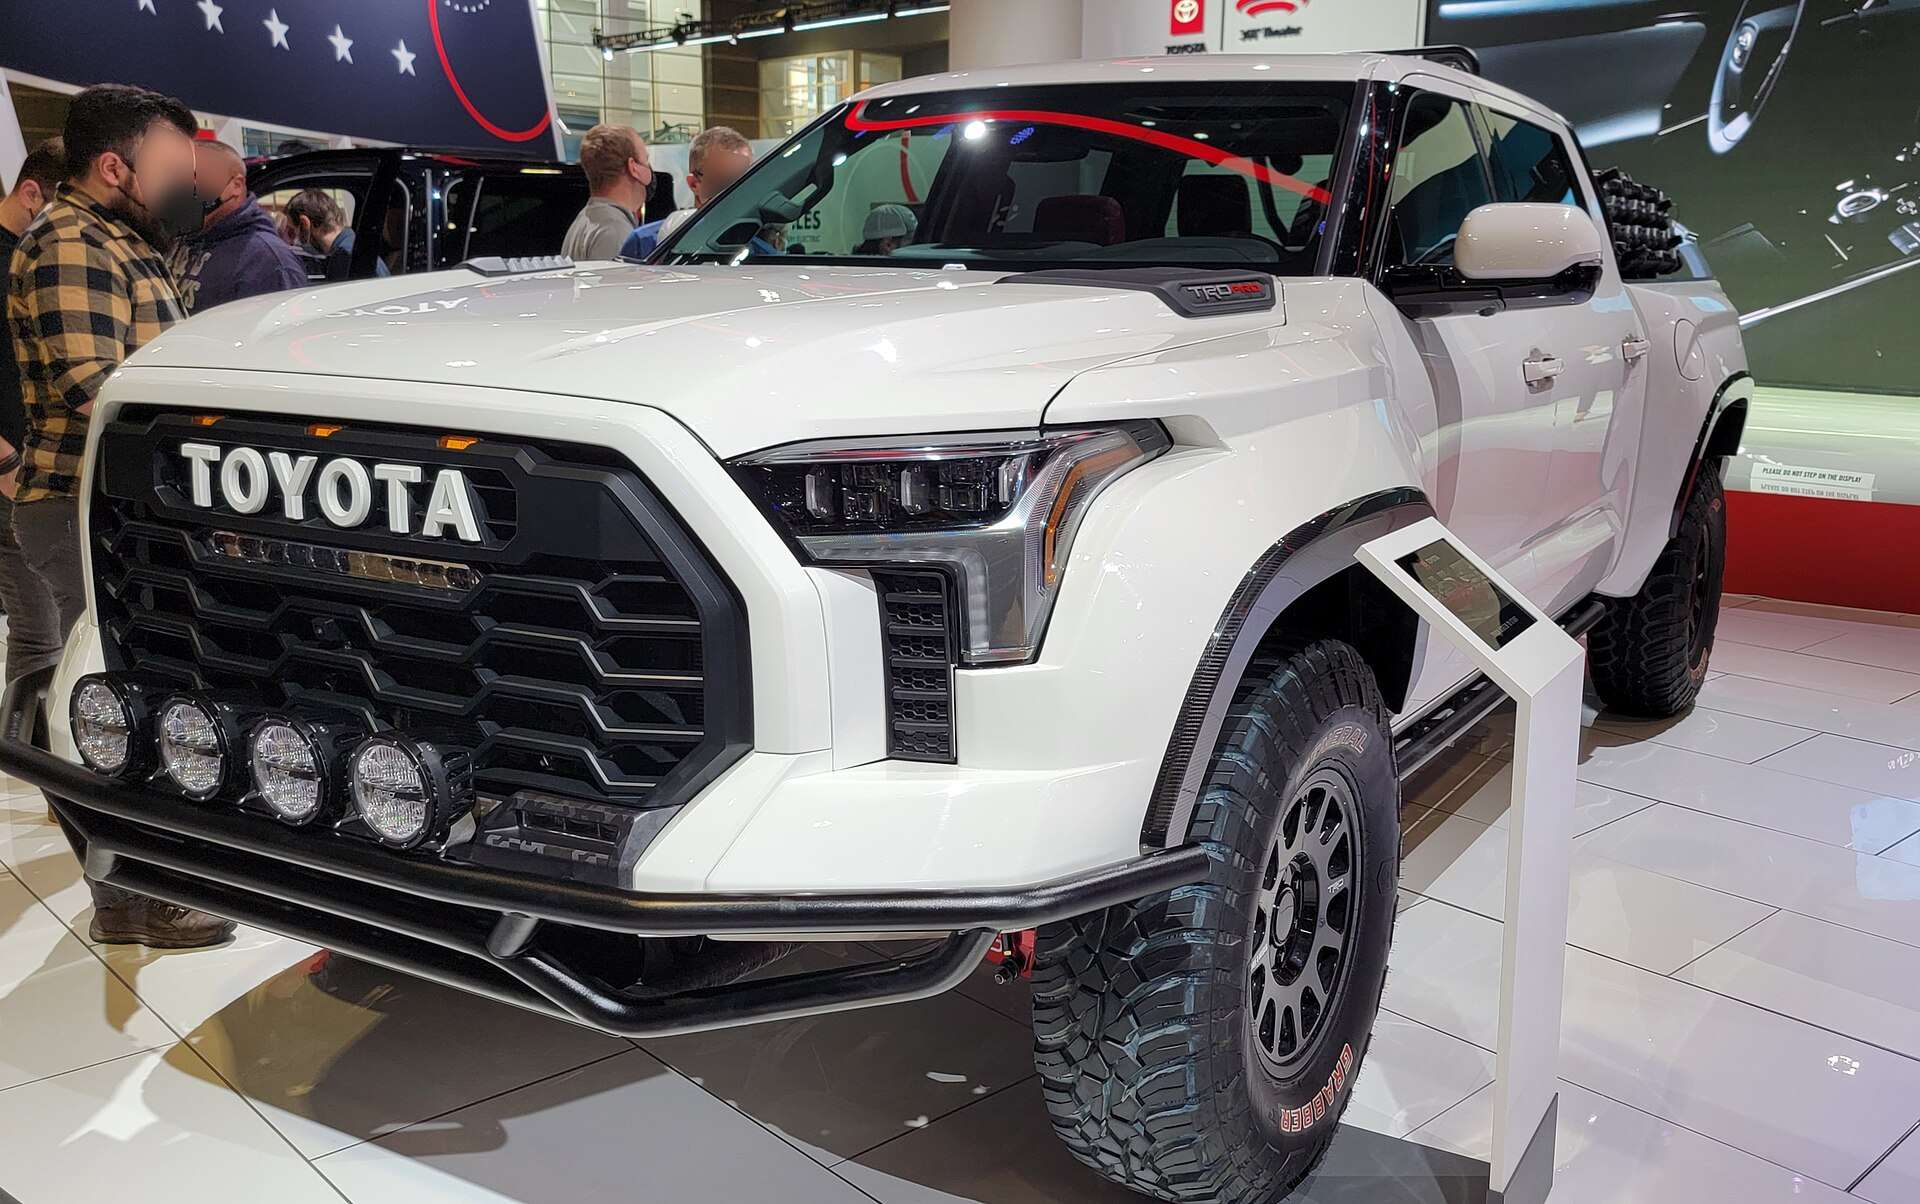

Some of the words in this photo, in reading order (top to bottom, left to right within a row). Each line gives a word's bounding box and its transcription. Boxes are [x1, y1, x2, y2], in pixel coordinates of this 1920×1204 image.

[1165, 43, 1207, 55] TOYOTA
[181, 442, 481, 542] TOYOTA
[1762, 467, 1781, 475] PLEASE
[1827, 473, 1837, 481] THE
[1838, 474, 1862, 482] DISPLAY
[1280, 1042, 1354, 1132] GRABBER
